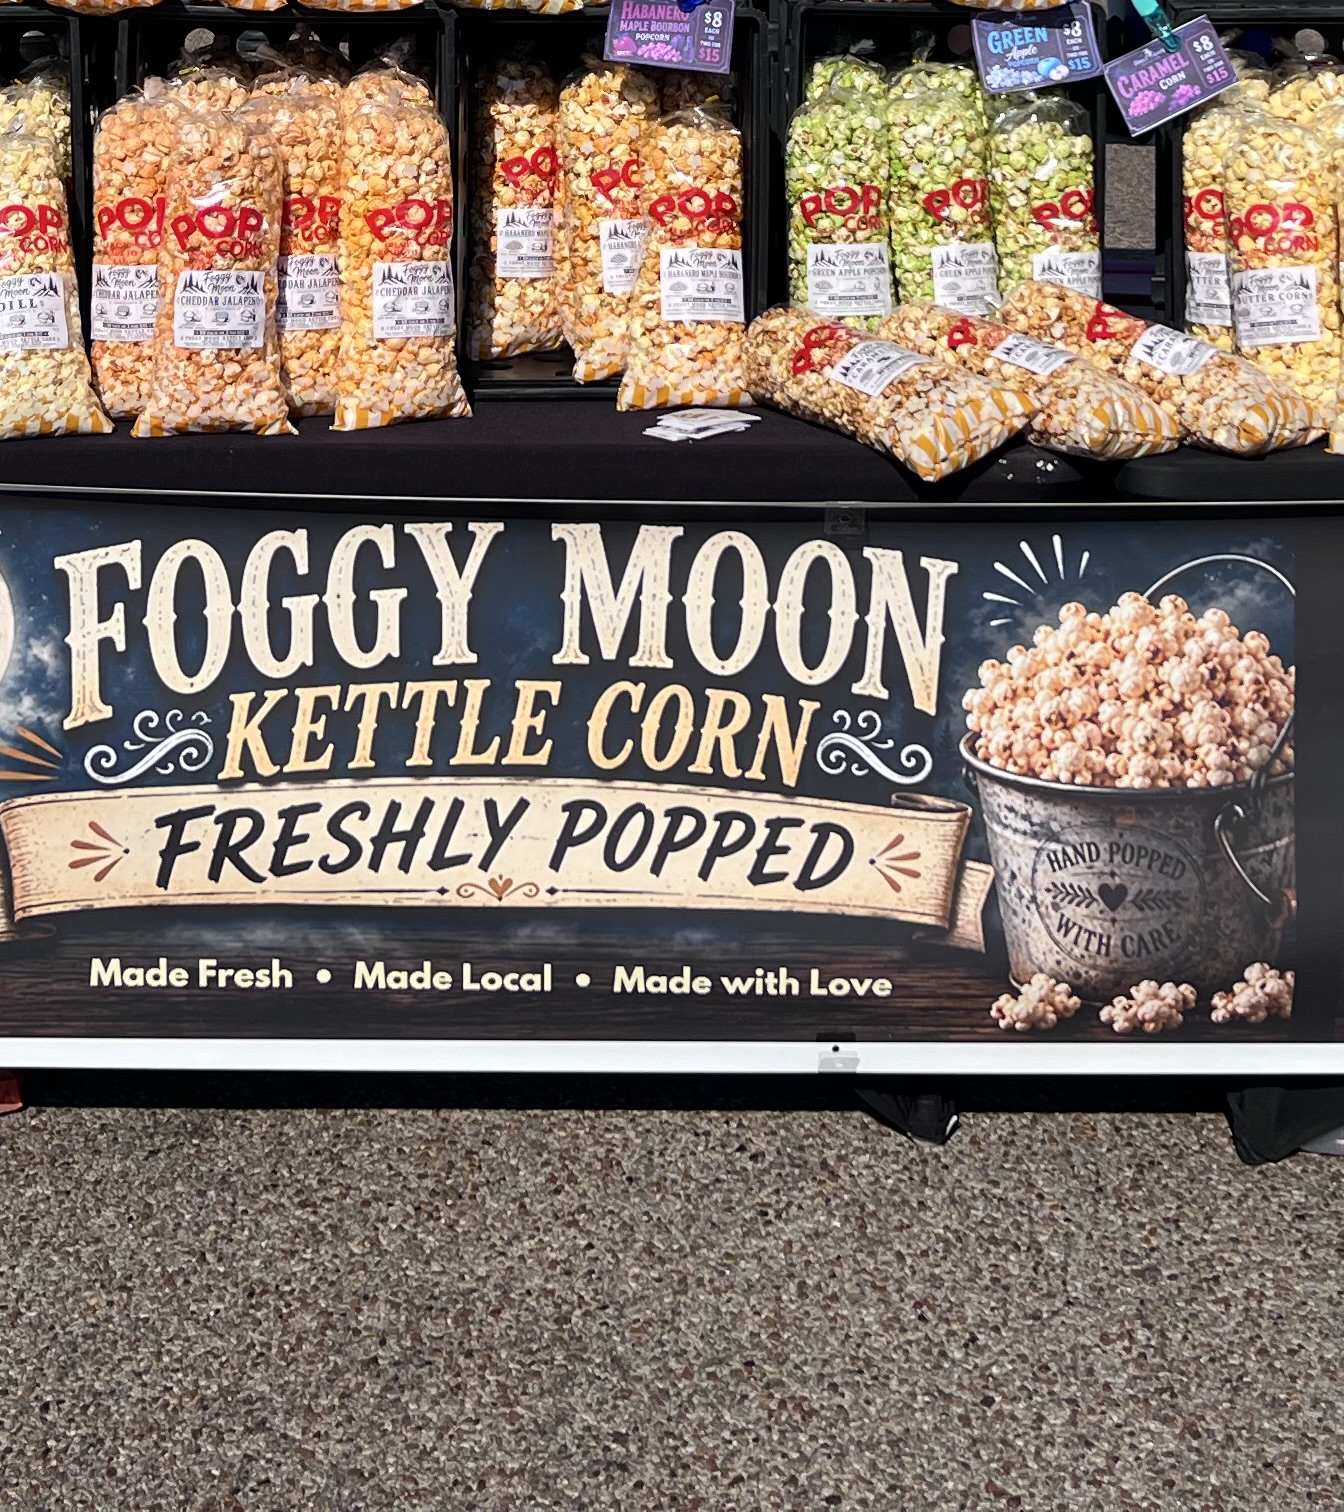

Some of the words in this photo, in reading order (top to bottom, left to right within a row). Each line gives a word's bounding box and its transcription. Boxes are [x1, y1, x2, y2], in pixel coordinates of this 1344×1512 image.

[619, 20, 649, 32] MAPLE
[650, 20, 691, 34] BOURBON
[704, 11, 723, 28] $8
[1062, 20, 1083, 38] $8
[635, 33, 671, 42] POPCORN
[987, 25, 1049, 55] GREEN
[1192, 35, 1215, 53] $8
[698, 47, 721, 63] $15
[1003, 43, 1039, 63] Apple
[1067, 56, 1093, 71] $15
[1117, 52, 1190, 100] CARAMEL
[1158, 70, 1187, 90] CORN
[1205, 67, 1229, 85] $15
[799, 184, 883, 228] POP
[170, 204, 265, 251] POP
[18, 234, 69, 255] CORN
[1263, 234, 1320, 255] CORN
[202, 271, 233, 286] Foggy
[811, 267, 836, 278] GREEN
[838, 268, 862, 278] APPLE
[206, 282, 237, 295] Moon
[378, 286, 418, 298] CHEDDAR
[1278, 291, 1309, 302] CORN
[179, 295, 220, 307] CHEDDAR
[54, 521, 505, 731] FOGGY
[551, 522, 959, 717] MOON
[217, 679, 562, 780] KETTLE
[587, 680, 821, 788] CORN
[155, 795, 531, 890] FRESHLY
[548, 798, 855, 892] POPPED
[1045, 840, 1102, 873] HAND
[1107, 840, 1188, 882] POPPED
[1055, 912, 1112, 959] WITH
[1120, 918, 1182, 959] CARE
[89, 957, 189, 988] Made
[198, 957, 294, 989] Fresh
[353, 960, 453, 990] Made
[462, 962, 553, 993] Local
[613, 965, 712, 995] Made
[720, 967, 800, 997] with
[809, 967, 893, 998] Love
